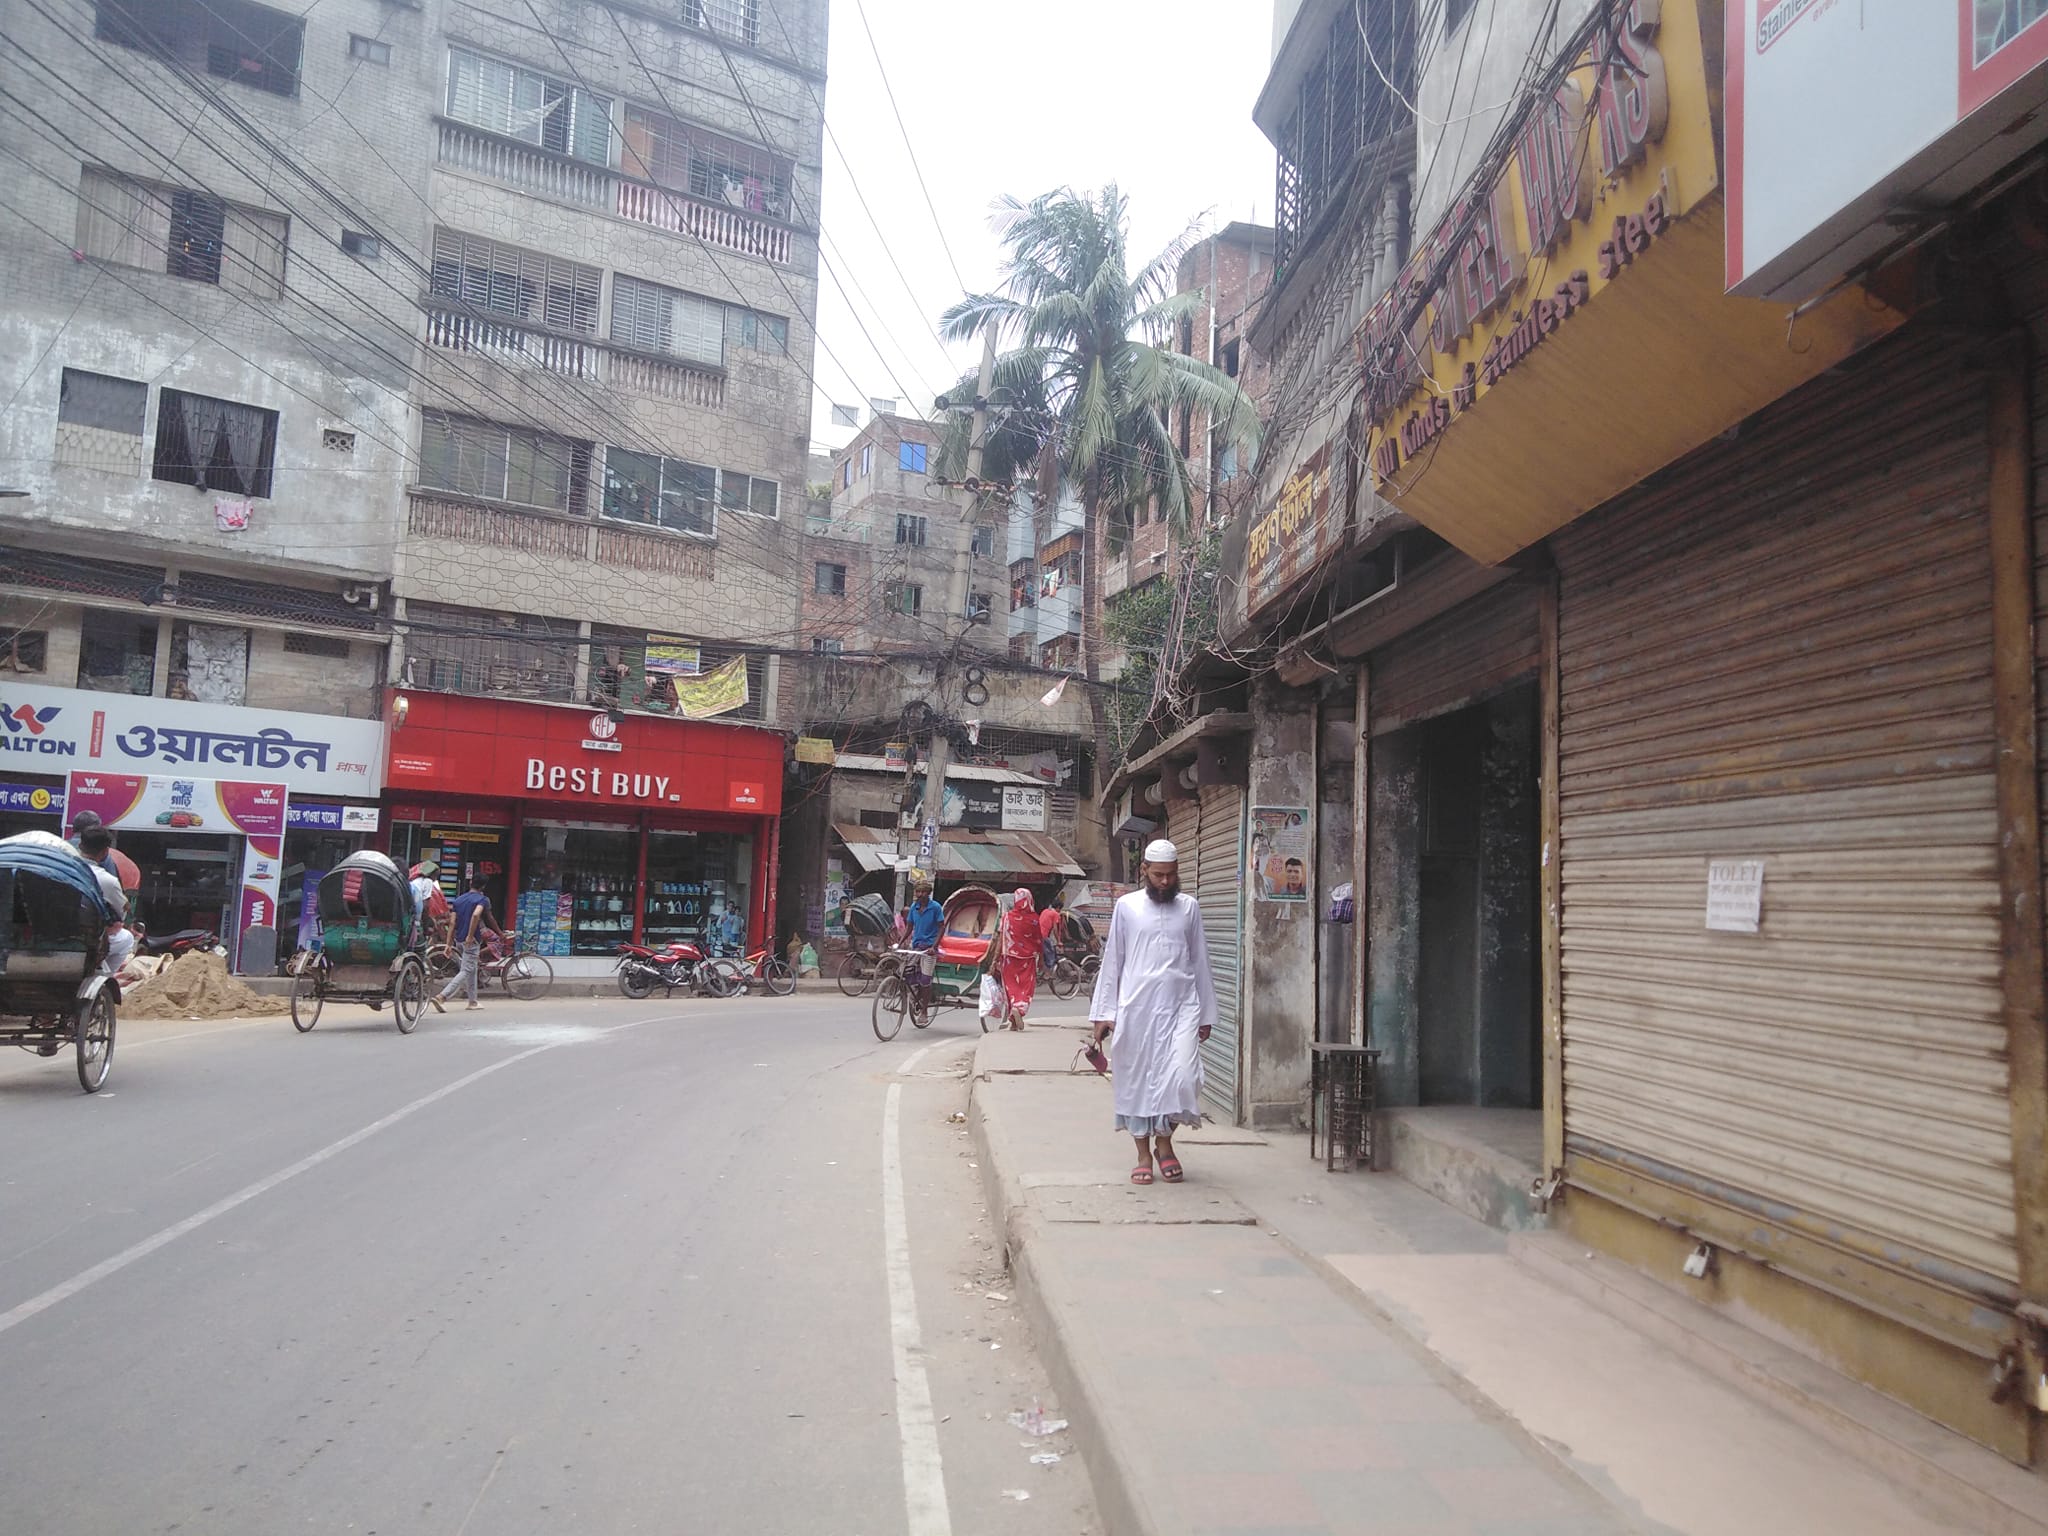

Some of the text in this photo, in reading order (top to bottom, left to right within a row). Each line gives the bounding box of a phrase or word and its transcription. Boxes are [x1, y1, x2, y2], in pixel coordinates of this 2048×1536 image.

[1453, 362, 1477, 412] of
[1482, 268, 1590, 388] stainless
[1598, 165, 1674, 280] steel
[0, 736, 77, 756] ALTON
[116, 725, 330, 772] ওয়ালটন
[526, 758, 670, 799] Best BUY
[77, 787, 105, 796] WALTON
[253, 797, 279, 806] WALTON
[1005, 790, 1043, 807] ভাই ভাই
